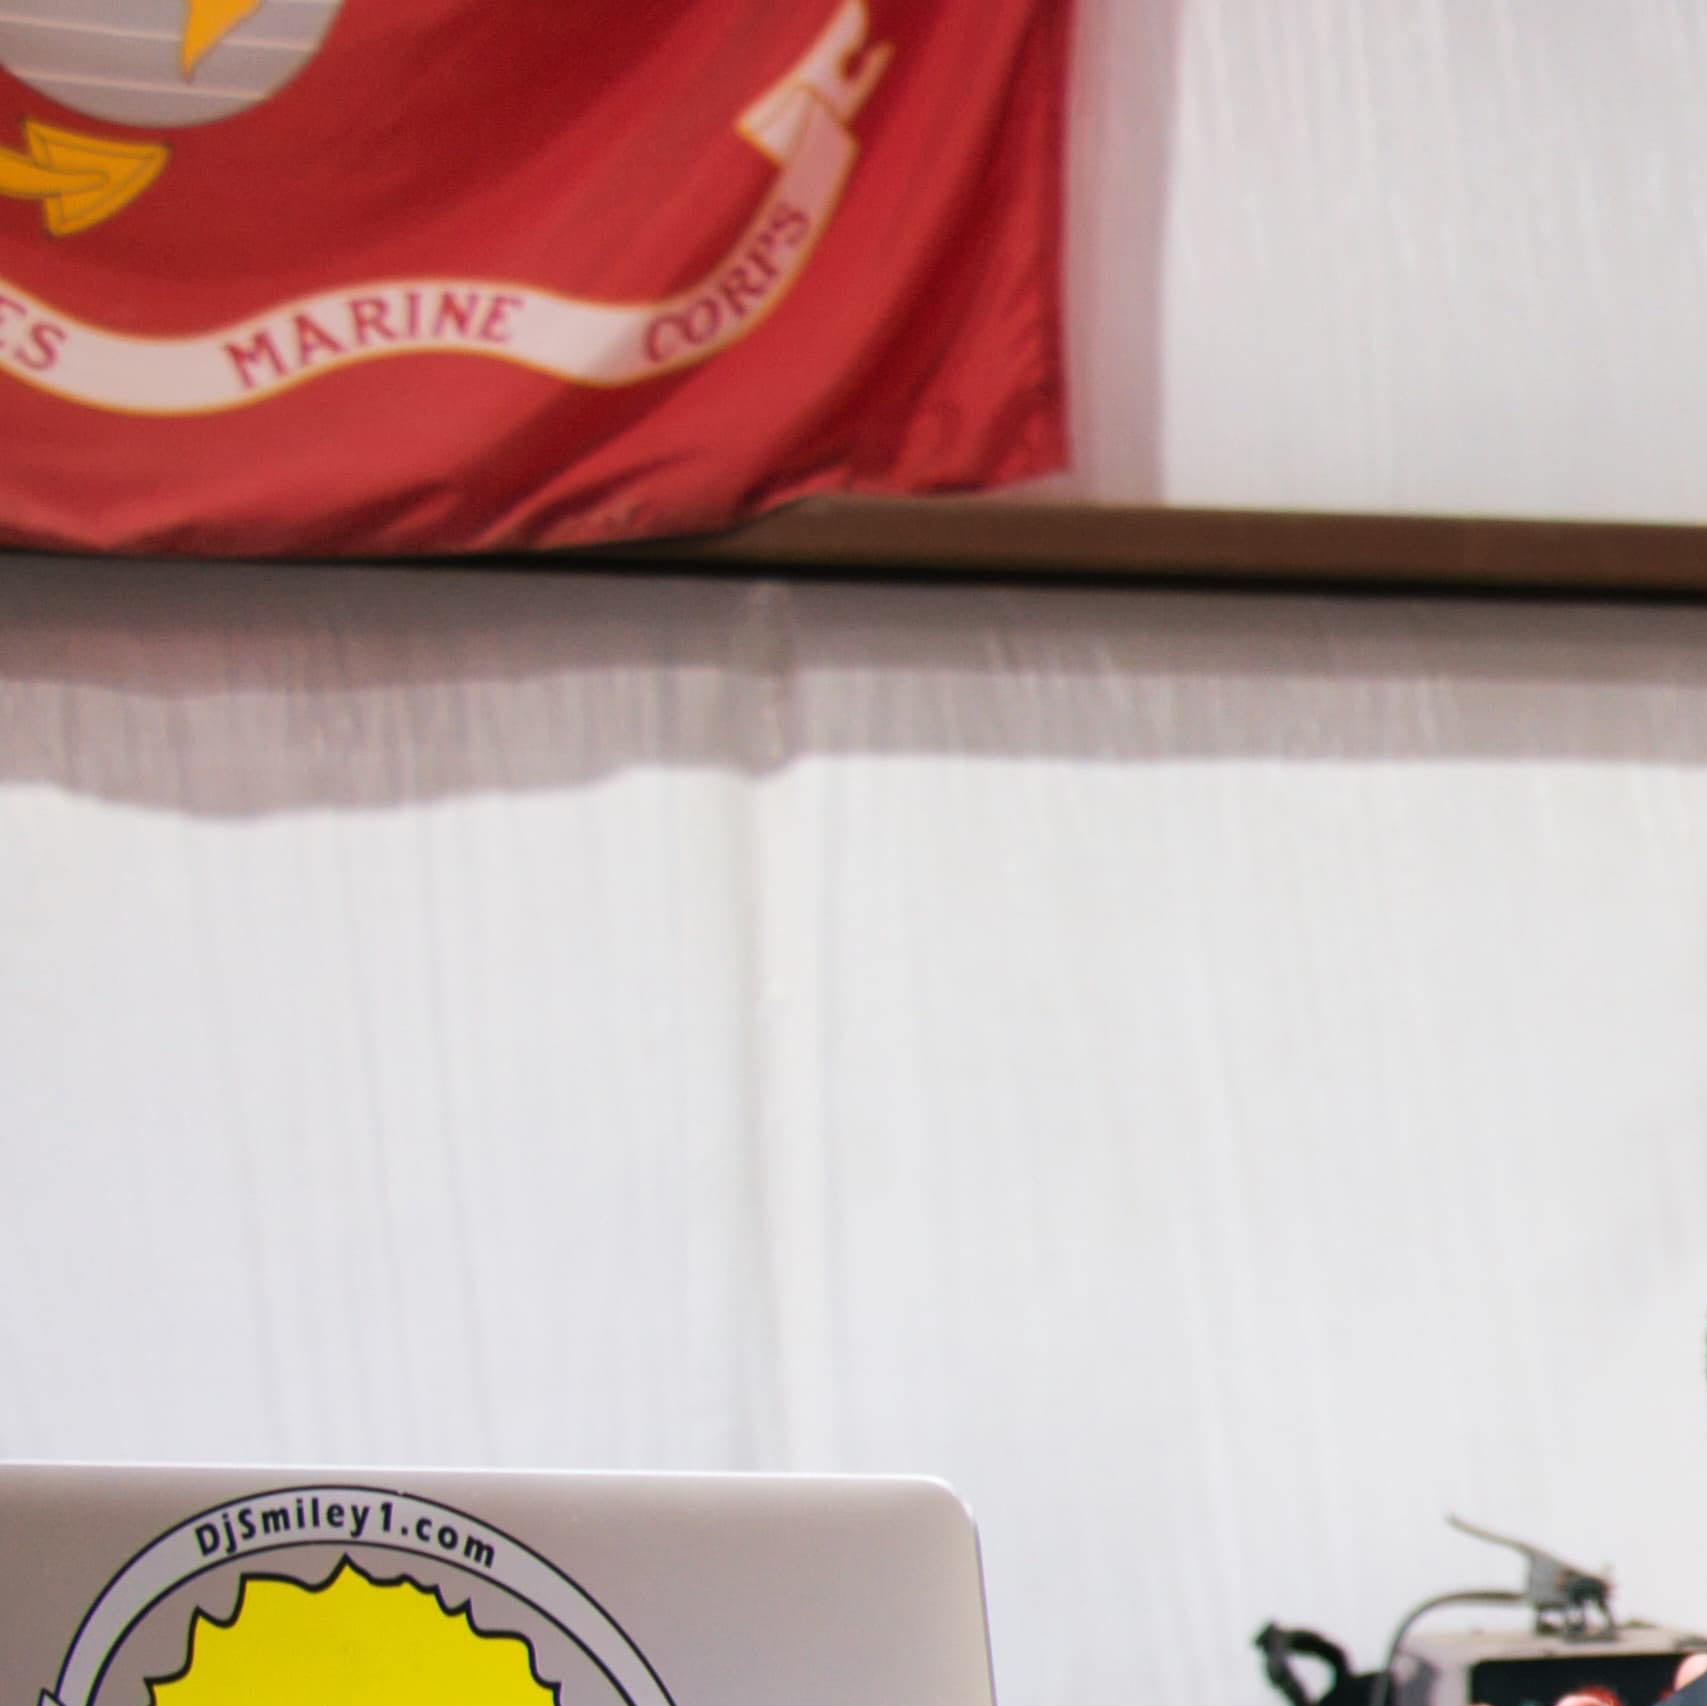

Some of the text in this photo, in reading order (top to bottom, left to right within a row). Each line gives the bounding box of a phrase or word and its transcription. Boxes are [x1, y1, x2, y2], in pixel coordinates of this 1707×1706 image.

[222, 291, 526, 389] MARINE
[643, 204, 811, 363] CORPS
[194, 1498, 497, 1570] DjSmiley1.com
